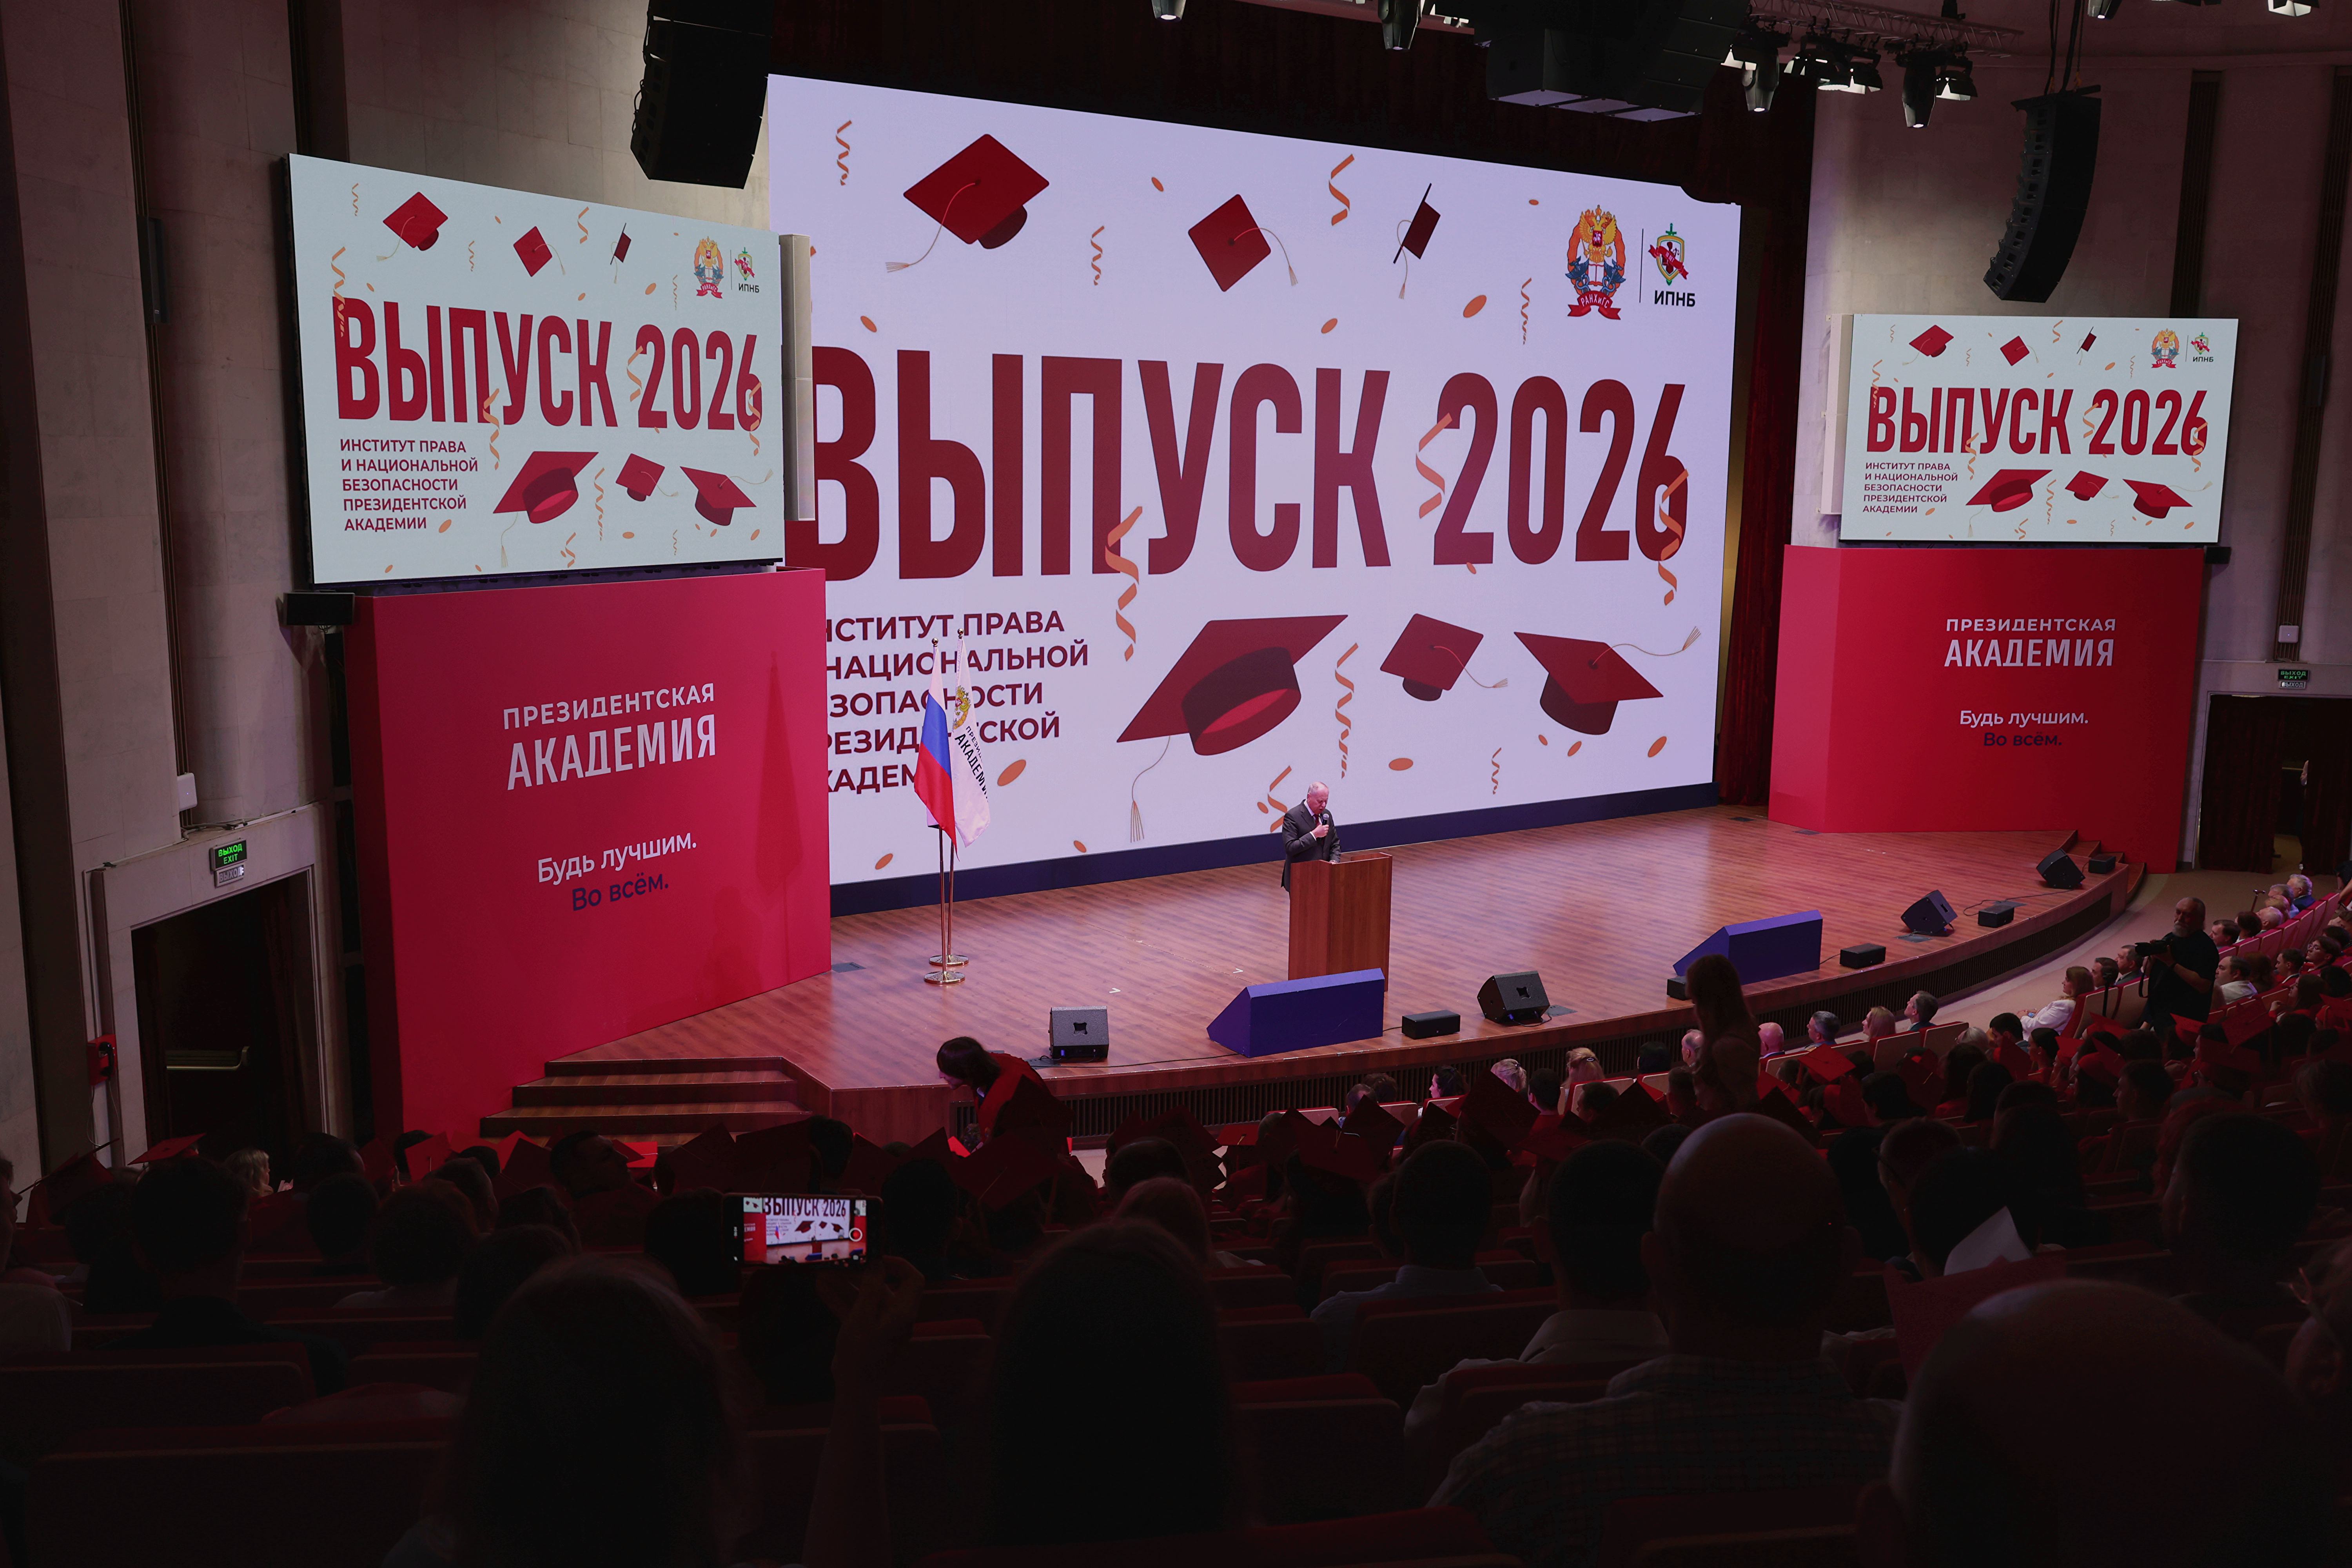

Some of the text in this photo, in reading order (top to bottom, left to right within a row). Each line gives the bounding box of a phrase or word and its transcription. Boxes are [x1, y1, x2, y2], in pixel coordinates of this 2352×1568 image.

[739, 283, 759, 293] ИПНБ
[1581, 294, 1610, 309] РАНХиГС
[1654, 290, 1695, 307] ИПНБ
[332, 296, 762, 431] ВЫПУСК 2026
[1866, 387, 2208, 456] ВЫПУСК 2026
[340, 439, 466, 453] ИНСТИТУТ ПРАВА
[341, 457, 478, 474] И НАЦИОНАЛЬНОЙ
[785, 346, 1689, 581] ВЫПУСК 2026
[343, 479, 457, 491] БЕЗОПАСНОСТИ
[1875, 472, 1958, 482] НАЦИОНАЛЬНОЙ
[343, 494, 466, 512] ПРЕЗИДЕНТСКОЙ
[1864, 494, 1947, 503] ПРЕЗИДЕНТСКОЙ
[1863, 506, 1917, 514] АКАДЕМИИ
[344, 517, 426, 532] АКАДЕМИИ
[826, 610, 1065, 642] СТИТУТ ПРАВА
[1946, 619, 2116, 632] ПРЕЗИДЕНТСКАЯ
[1944, 639, 2114, 667] АКАДЕМИЯ
[503, 682, 715, 730] ПРЕЗИДЕНТСКАЯ
[1960, 710, 2089, 728] Будь лучшим.
[1984, 732, 2062, 746] Во всём.
[507, 714, 716, 790] АКАДЕМИЯ
[955, 734, 988, 802] АКАДЕМ
[218, 844, 242, 857] ВЫХОД
[223, 853, 238, 864] EXIT
[538, 833, 697, 885] Будь лучшим.
[572, 873, 669, 911] Во всём.
[824, 1199, 846, 1217] 2026
